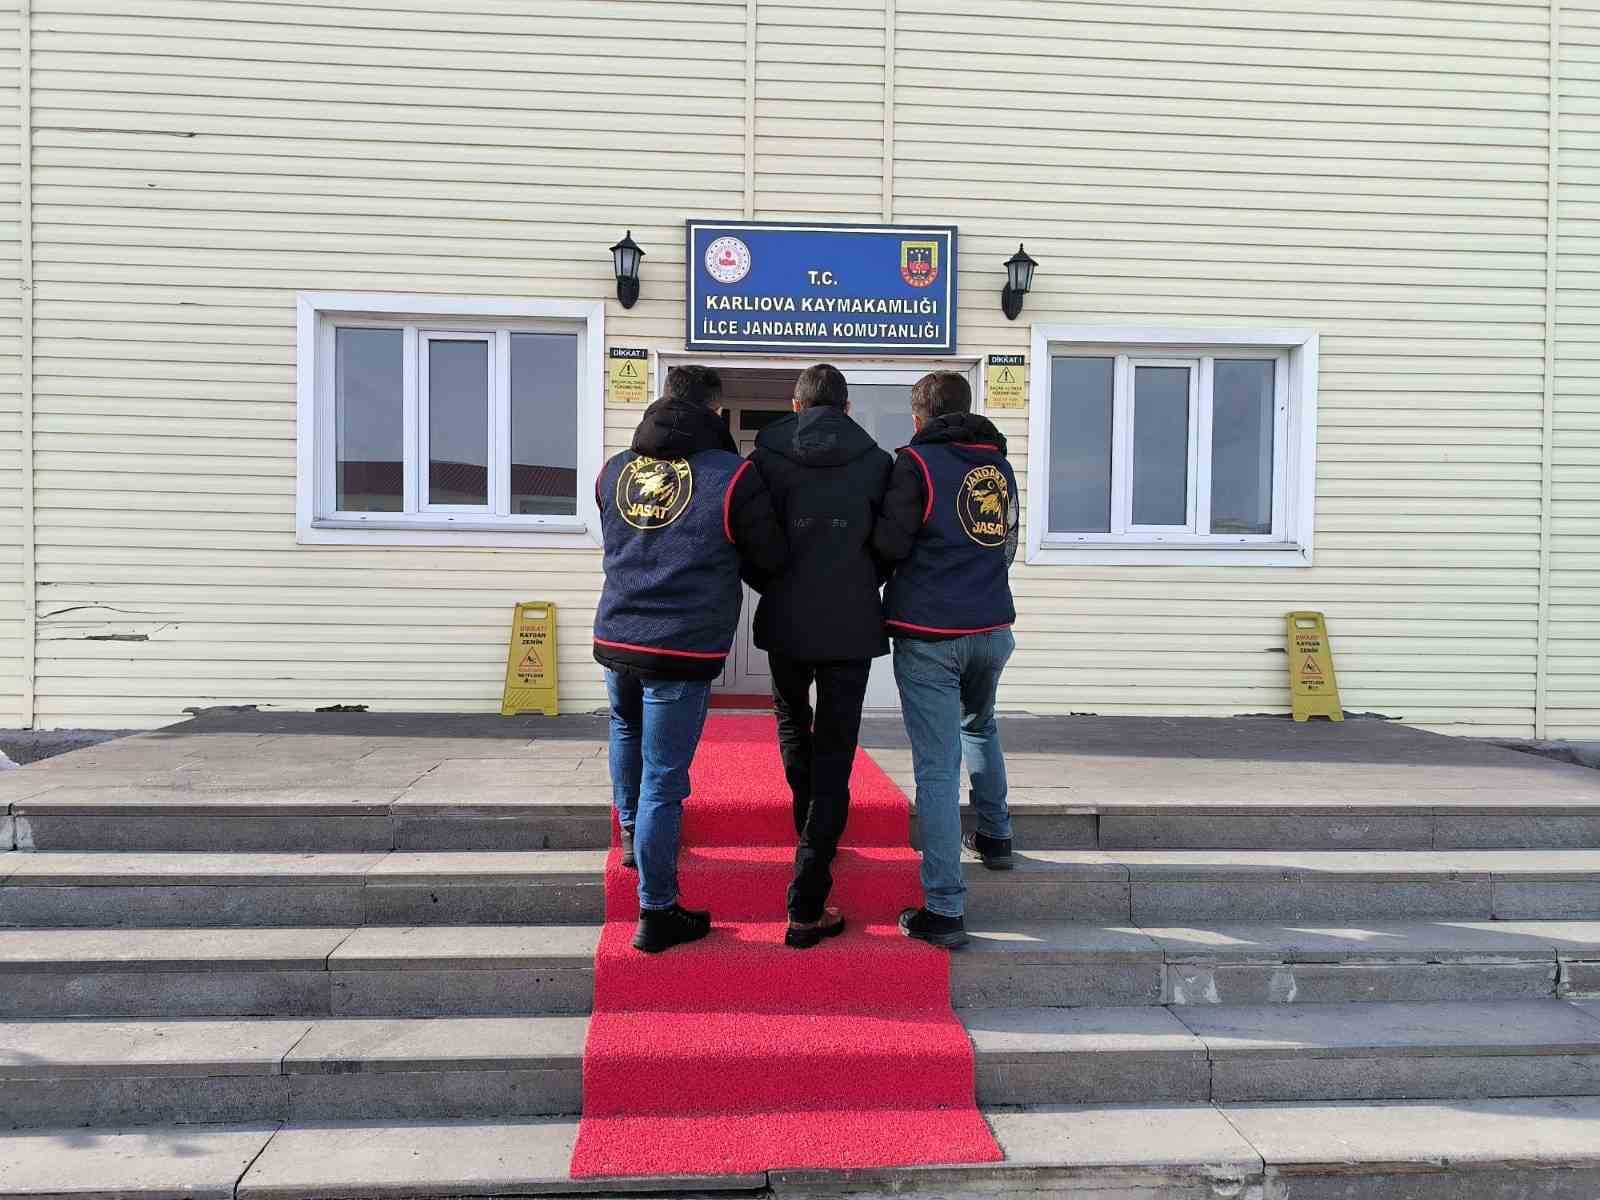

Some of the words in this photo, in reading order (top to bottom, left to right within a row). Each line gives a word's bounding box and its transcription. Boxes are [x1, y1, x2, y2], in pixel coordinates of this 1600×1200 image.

[807, 271, 838, 286] T.C.
[706, 295, 795, 311] KARLIOVA
[801, 296, 937, 314] KAYMAKAMLIĞI
[703, 316, 738, 335] İLÇE
[742, 320, 828, 337] JANDARMA
[833, 321, 940, 338] KOMUTANLIĞI
[627, 503, 669, 519] JASAT
